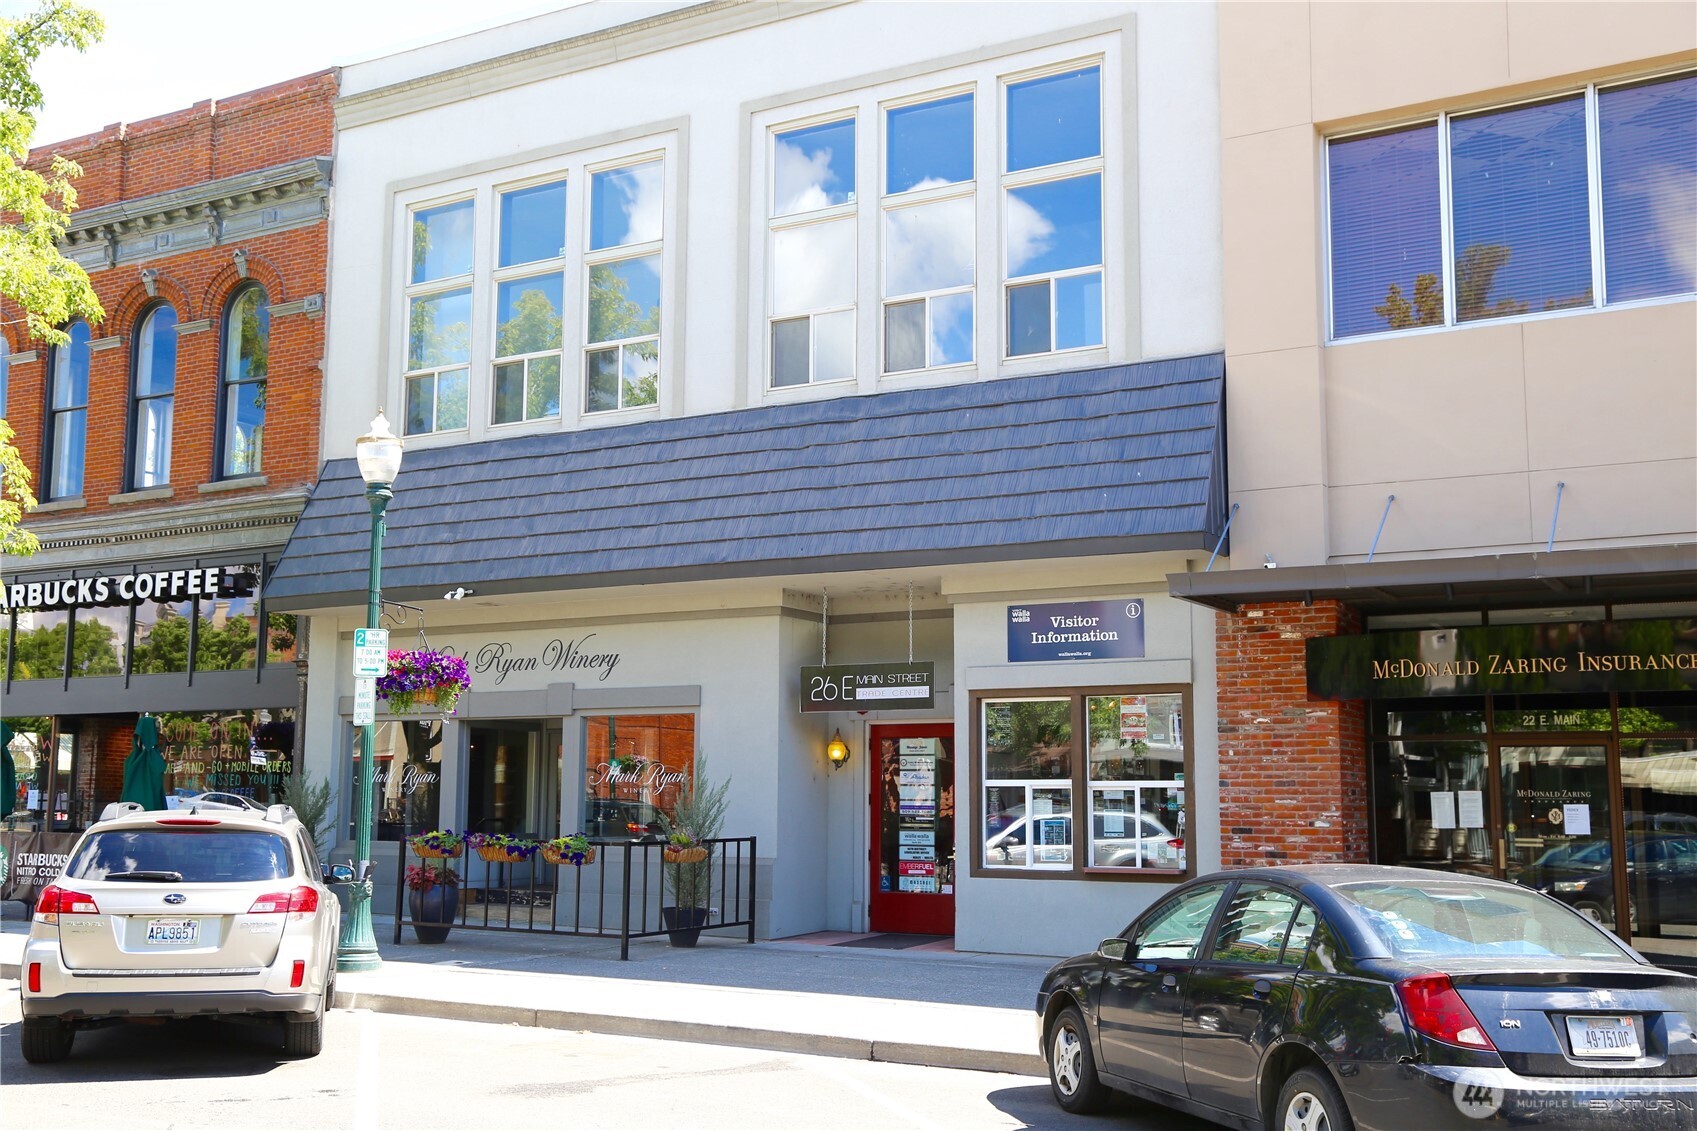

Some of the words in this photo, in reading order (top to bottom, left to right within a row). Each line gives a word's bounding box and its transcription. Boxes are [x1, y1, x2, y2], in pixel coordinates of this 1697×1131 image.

[119, 567, 220, 600] COFFEE
[1050, 615, 1099, 628] Visitor
[356, 632, 365, 646] 2
[1031, 629, 1119, 644] Information
[475, 642, 539, 685] Ryan
[542, 633, 621, 681] Winery
[1488, 654, 1568, 674] ZARING
[1577, 650, 1697, 672] INSURANCE
[811, 676, 838, 701] 26
[842, 675, 854, 700] E
[856, 675, 883, 685] MAIN
[887, 672, 929, 684] STREET
[857, 689, 886, 698] TRADE
[892, 688, 929, 697] CENTRE
[1522, 715, 1536, 726] 22
[1540, 714, 1550, 726] E.
[1553, 714, 1581, 725] MAIN
[166, 722, 200, 742] COME
[211, 721, 230, 740] ON
[180, 745, 203, 760] ARE
[211, 743, 243, 760] OPEN
[231, 761, 259, 774] MOBILE
[401, 764, 440, 794] Ryan
[588, 762, 649, 785] Mark
[645, 760, 691, 795] Ryan
[1561, 789, 1592, 798] ZARING
[17, 853, 67, 866] STARBUCKS
[16, 867, 37, 876] NITRO
[39, 867, 61, 876] COLD
[16, 877, 31, 885] FRESH
[1499, 1019, 1521, 1028] ION
[1589, 1098, 1695, 1112] SATURN
